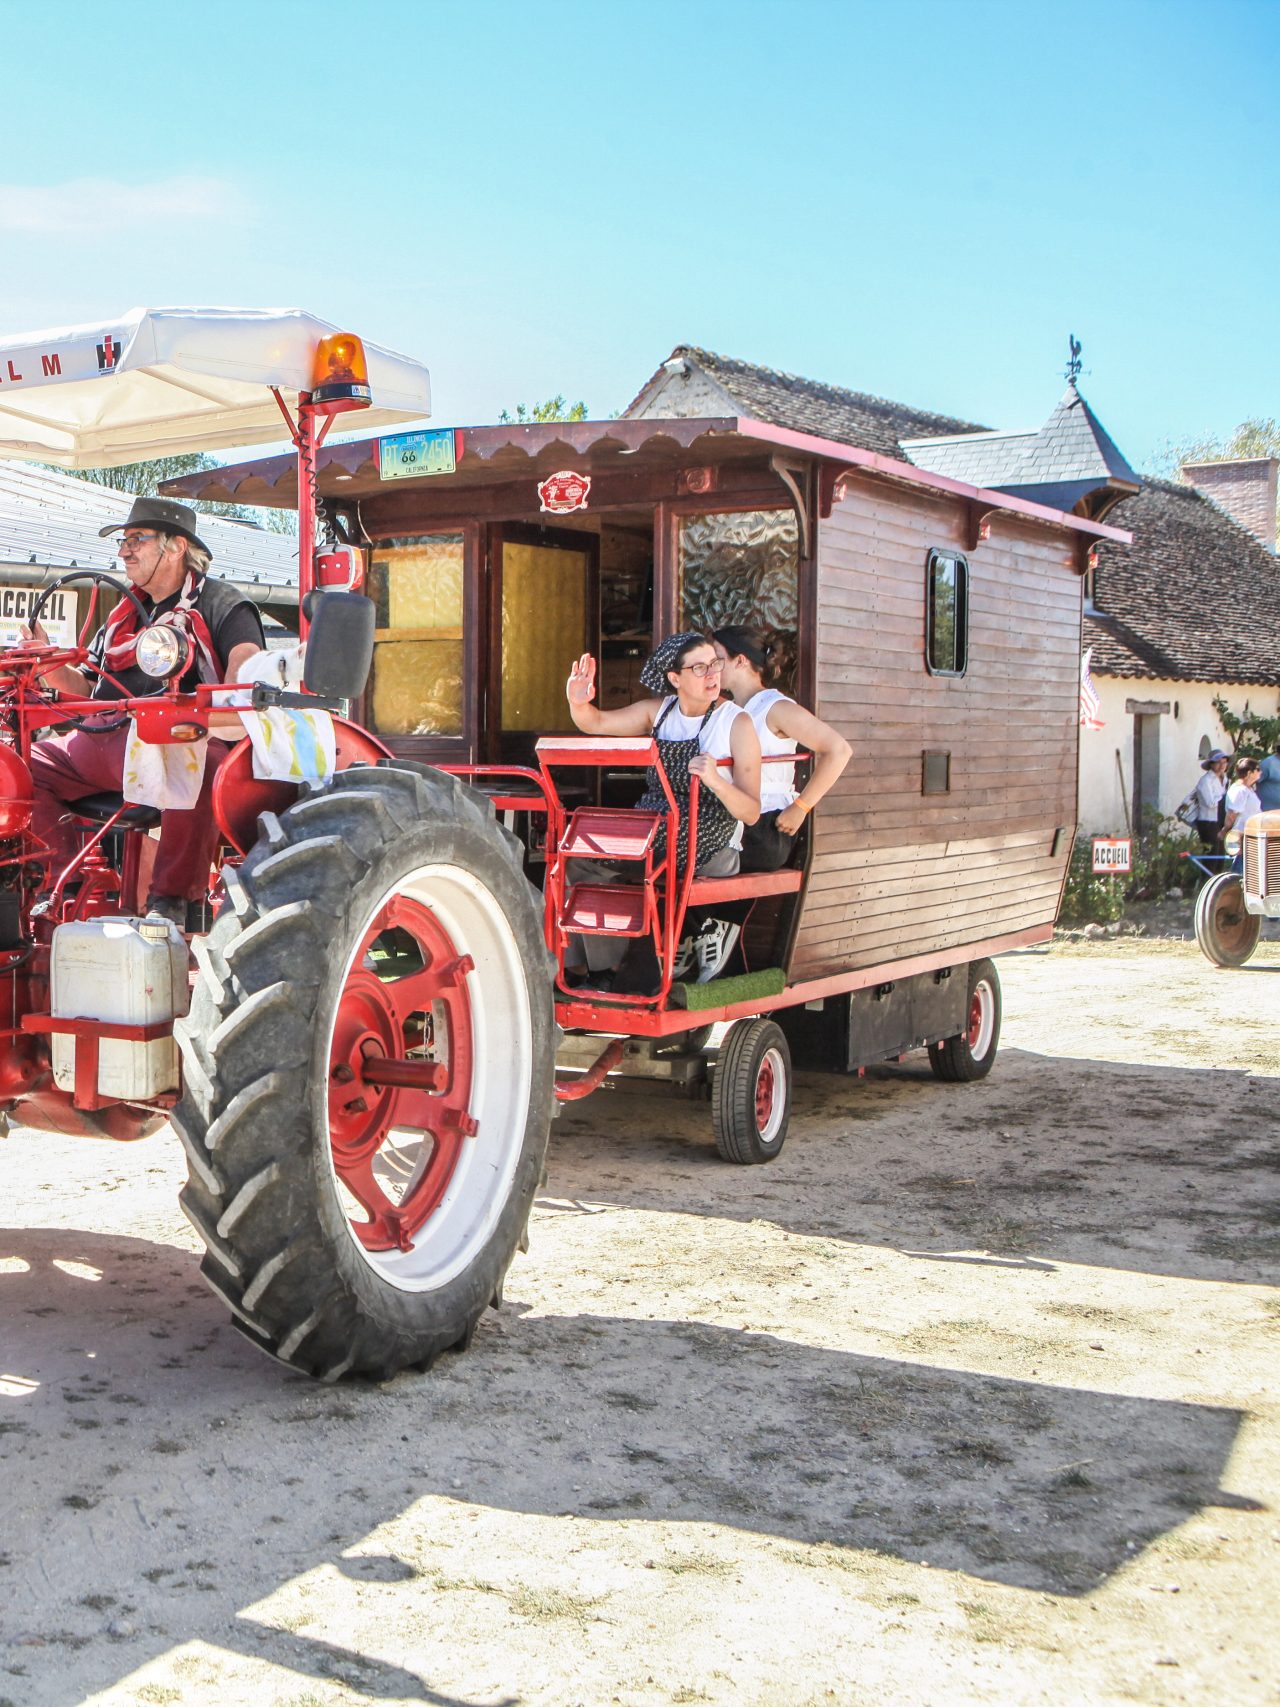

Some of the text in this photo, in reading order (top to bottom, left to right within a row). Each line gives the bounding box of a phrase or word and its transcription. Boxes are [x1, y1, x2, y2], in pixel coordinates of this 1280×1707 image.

[41, 353, 63, 377] M
[402, 451, 415, 462] 66
[421, 438, 450, 464] 2450
[1095, 848, 1128, 864] ACCUEIL
